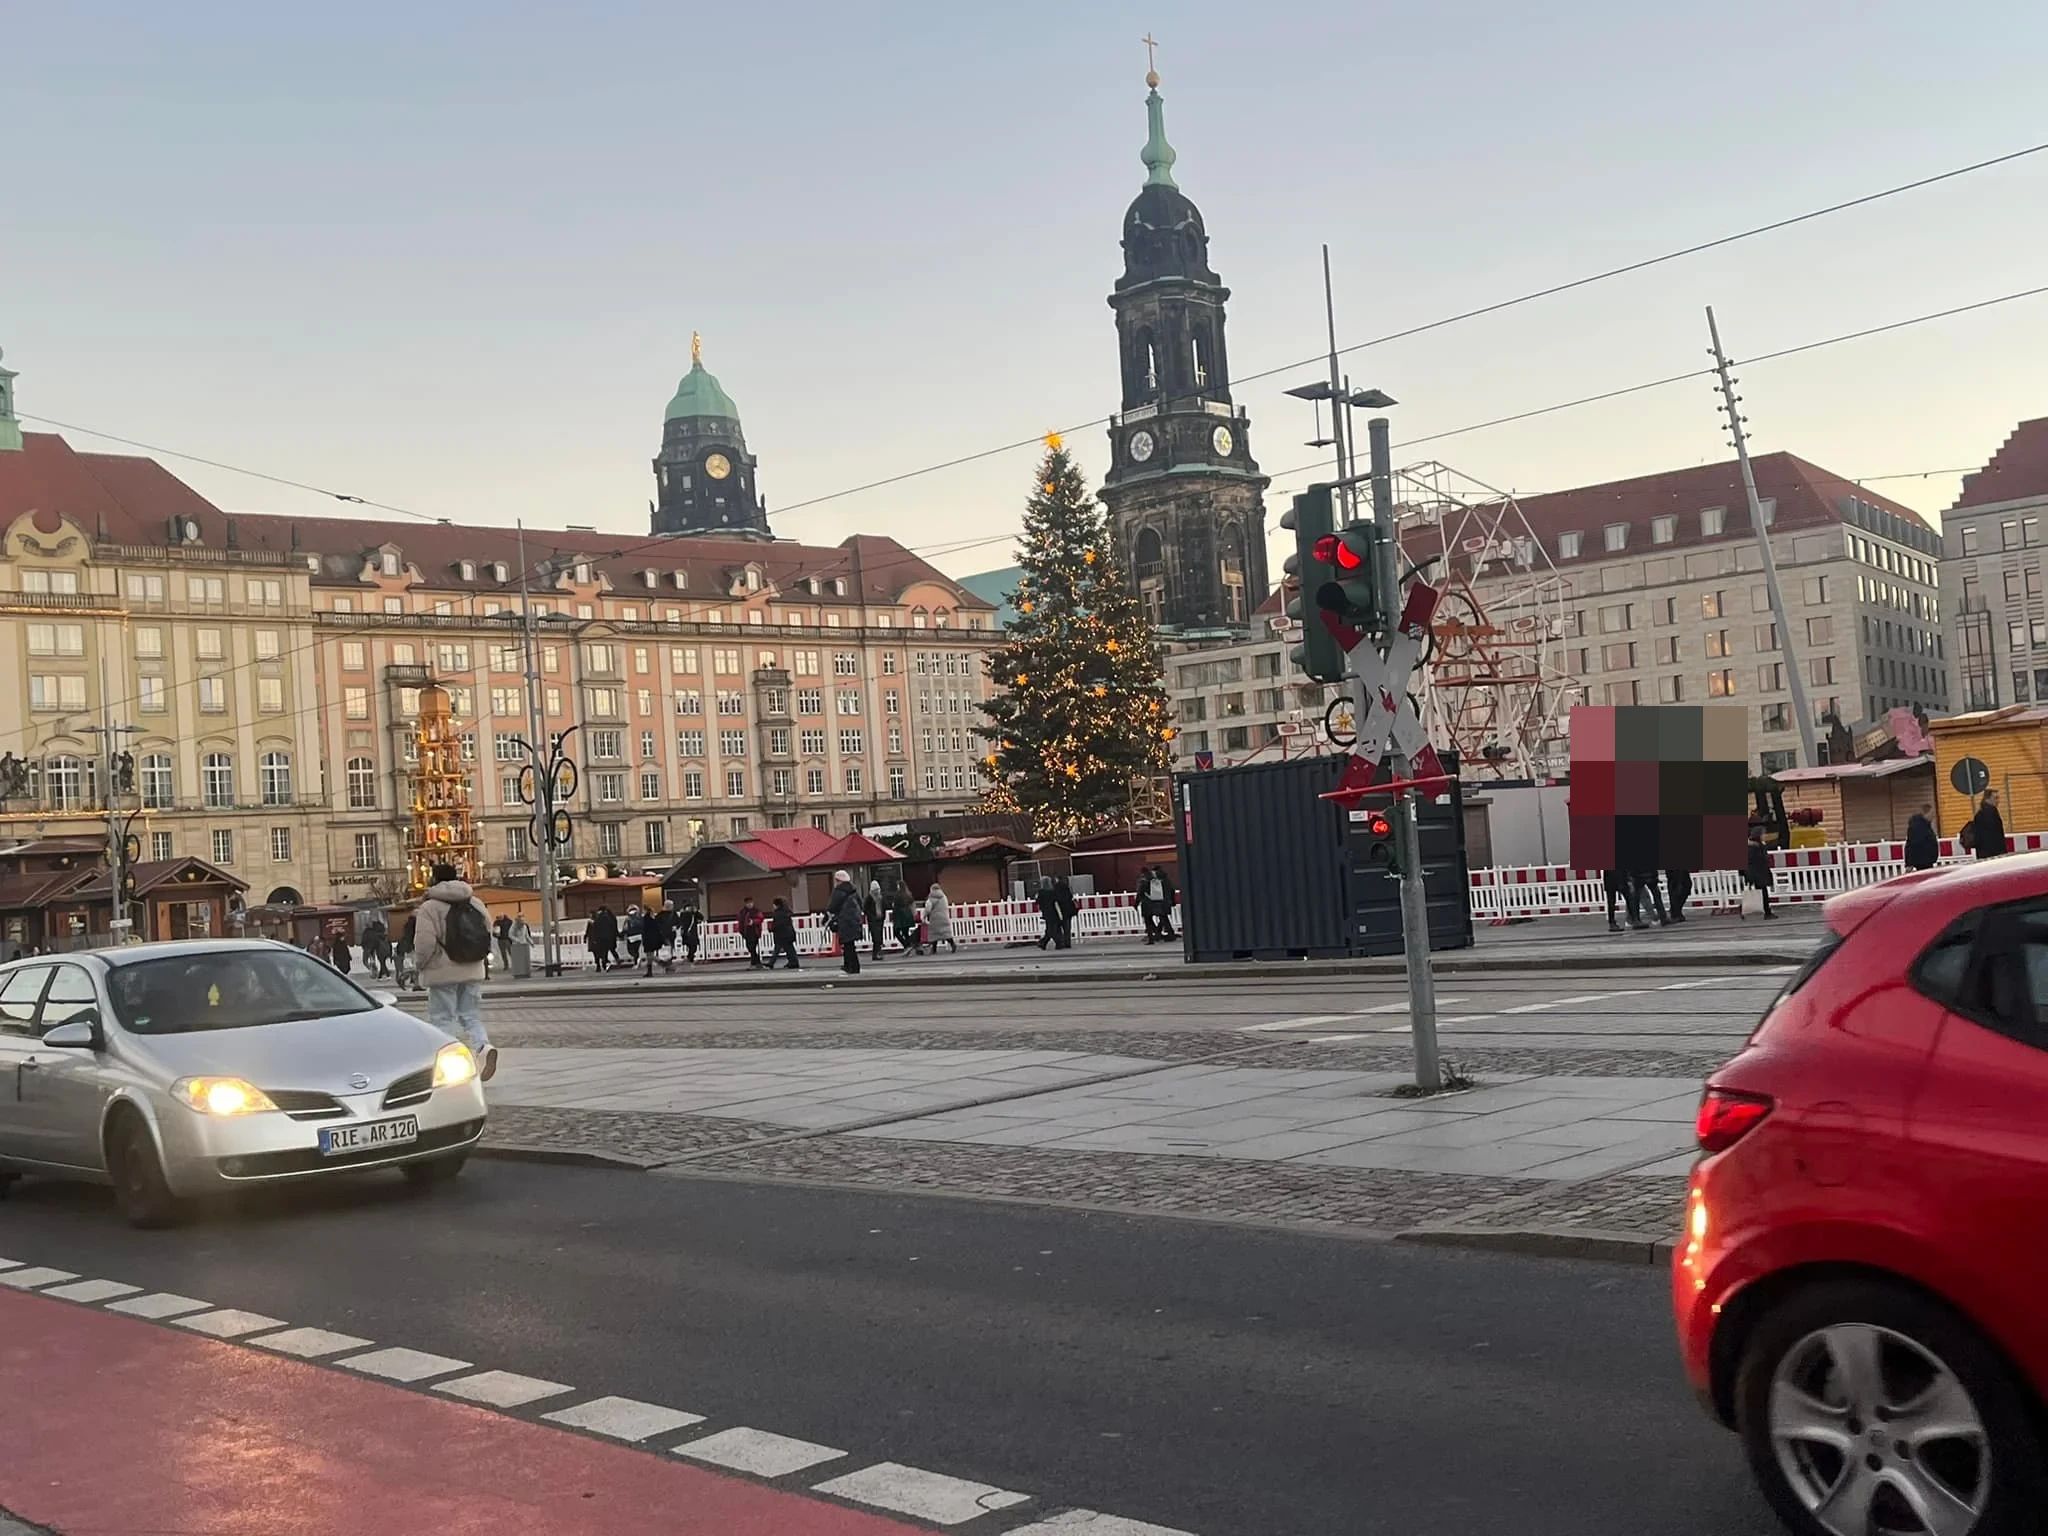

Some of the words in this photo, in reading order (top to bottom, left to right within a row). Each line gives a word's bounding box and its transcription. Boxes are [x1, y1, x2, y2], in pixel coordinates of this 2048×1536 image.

[330, 1128, 359, 1148] RIE
[370, 1125, 387, 1142] AR
[390, 1121, 415, 1139] 120
